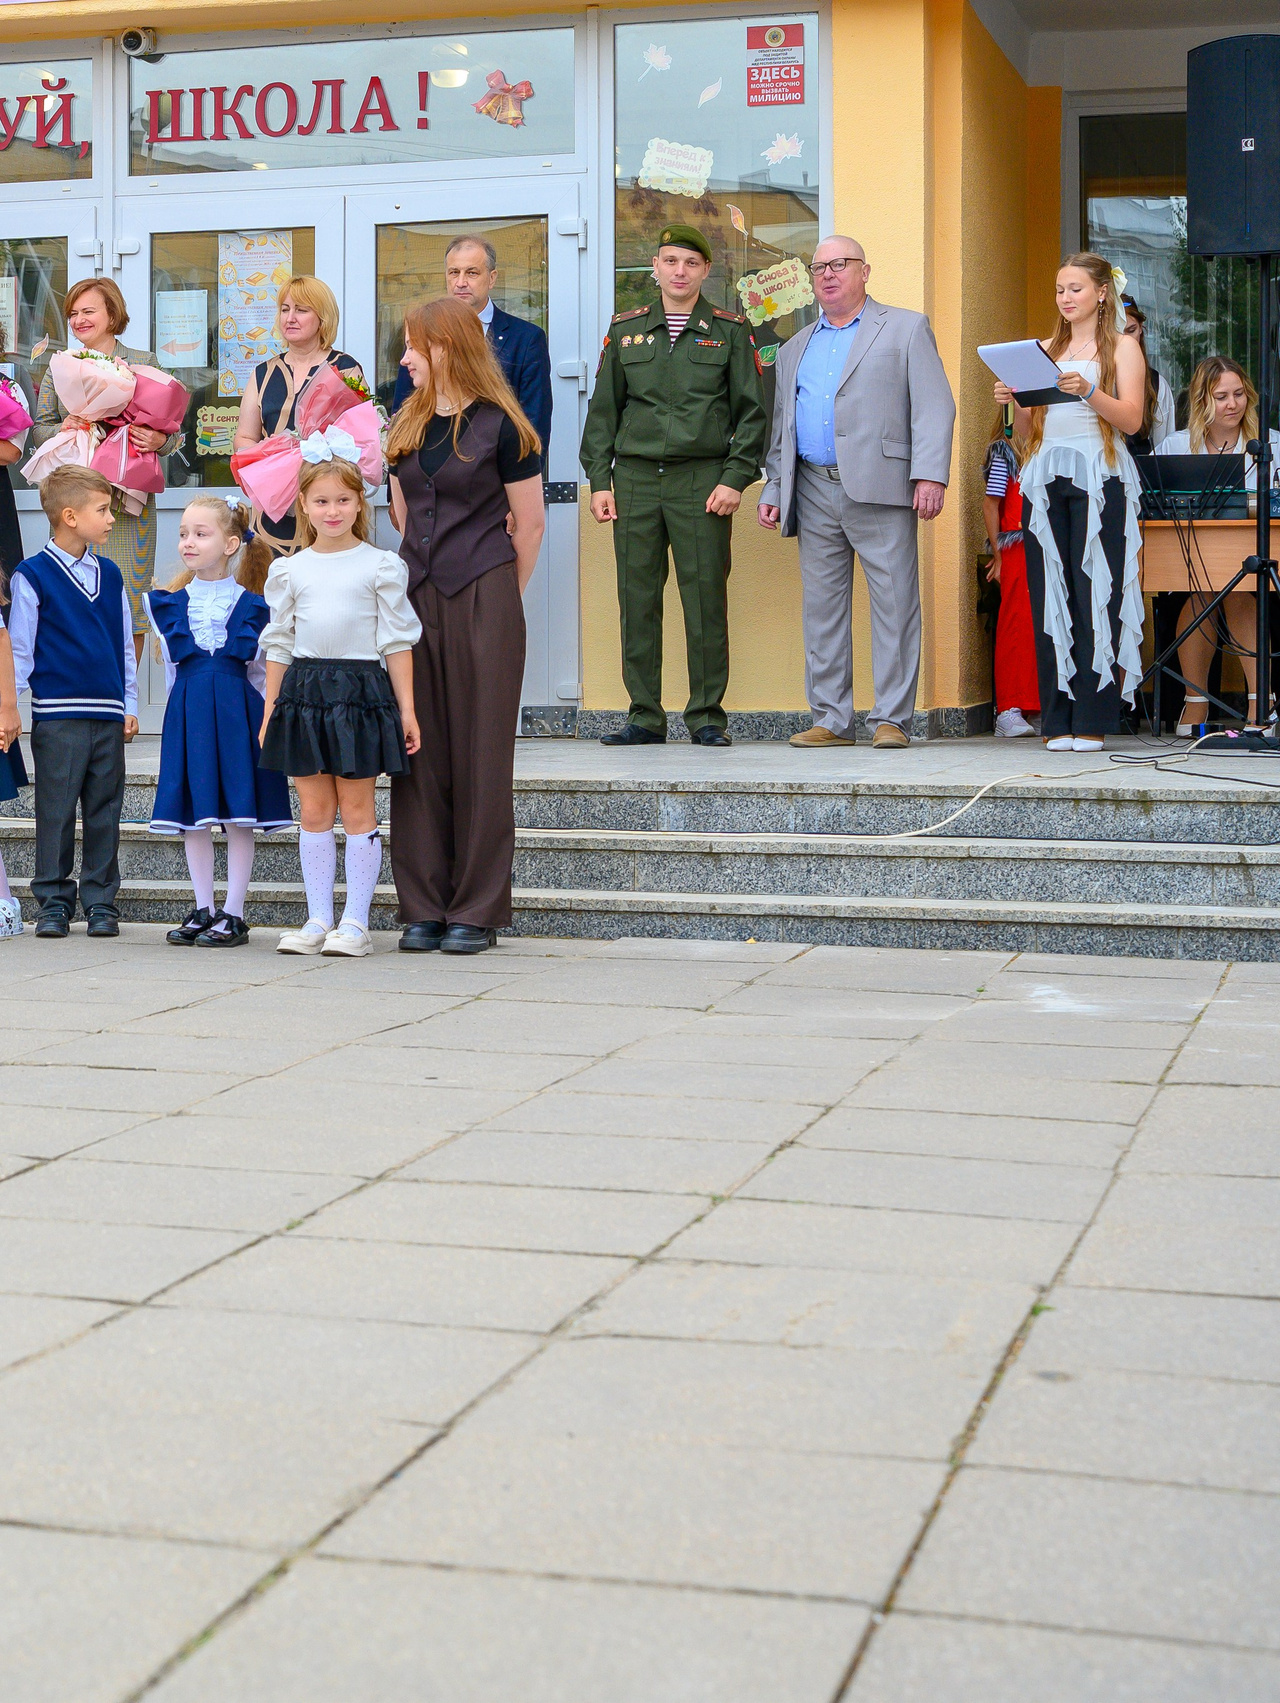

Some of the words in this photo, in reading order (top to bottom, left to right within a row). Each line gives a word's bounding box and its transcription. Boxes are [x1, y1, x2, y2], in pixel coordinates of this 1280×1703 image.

[750, 66, 800, 82] ЗДЕСЬ
[750, 92, 801, 102] МИЛИЦИЮ
[656, 142, 697, 161] Вперёд
[700, 154, 706, 162] к
[654, 156, 703, 174] знаниям!
[756, 267, 789, 285] Снова
[790, 264, 798, 272] в
[763, 273, 800, 296] школу!
[201, 414, 208, 422] С
[210, 413, 215, 422] 1
